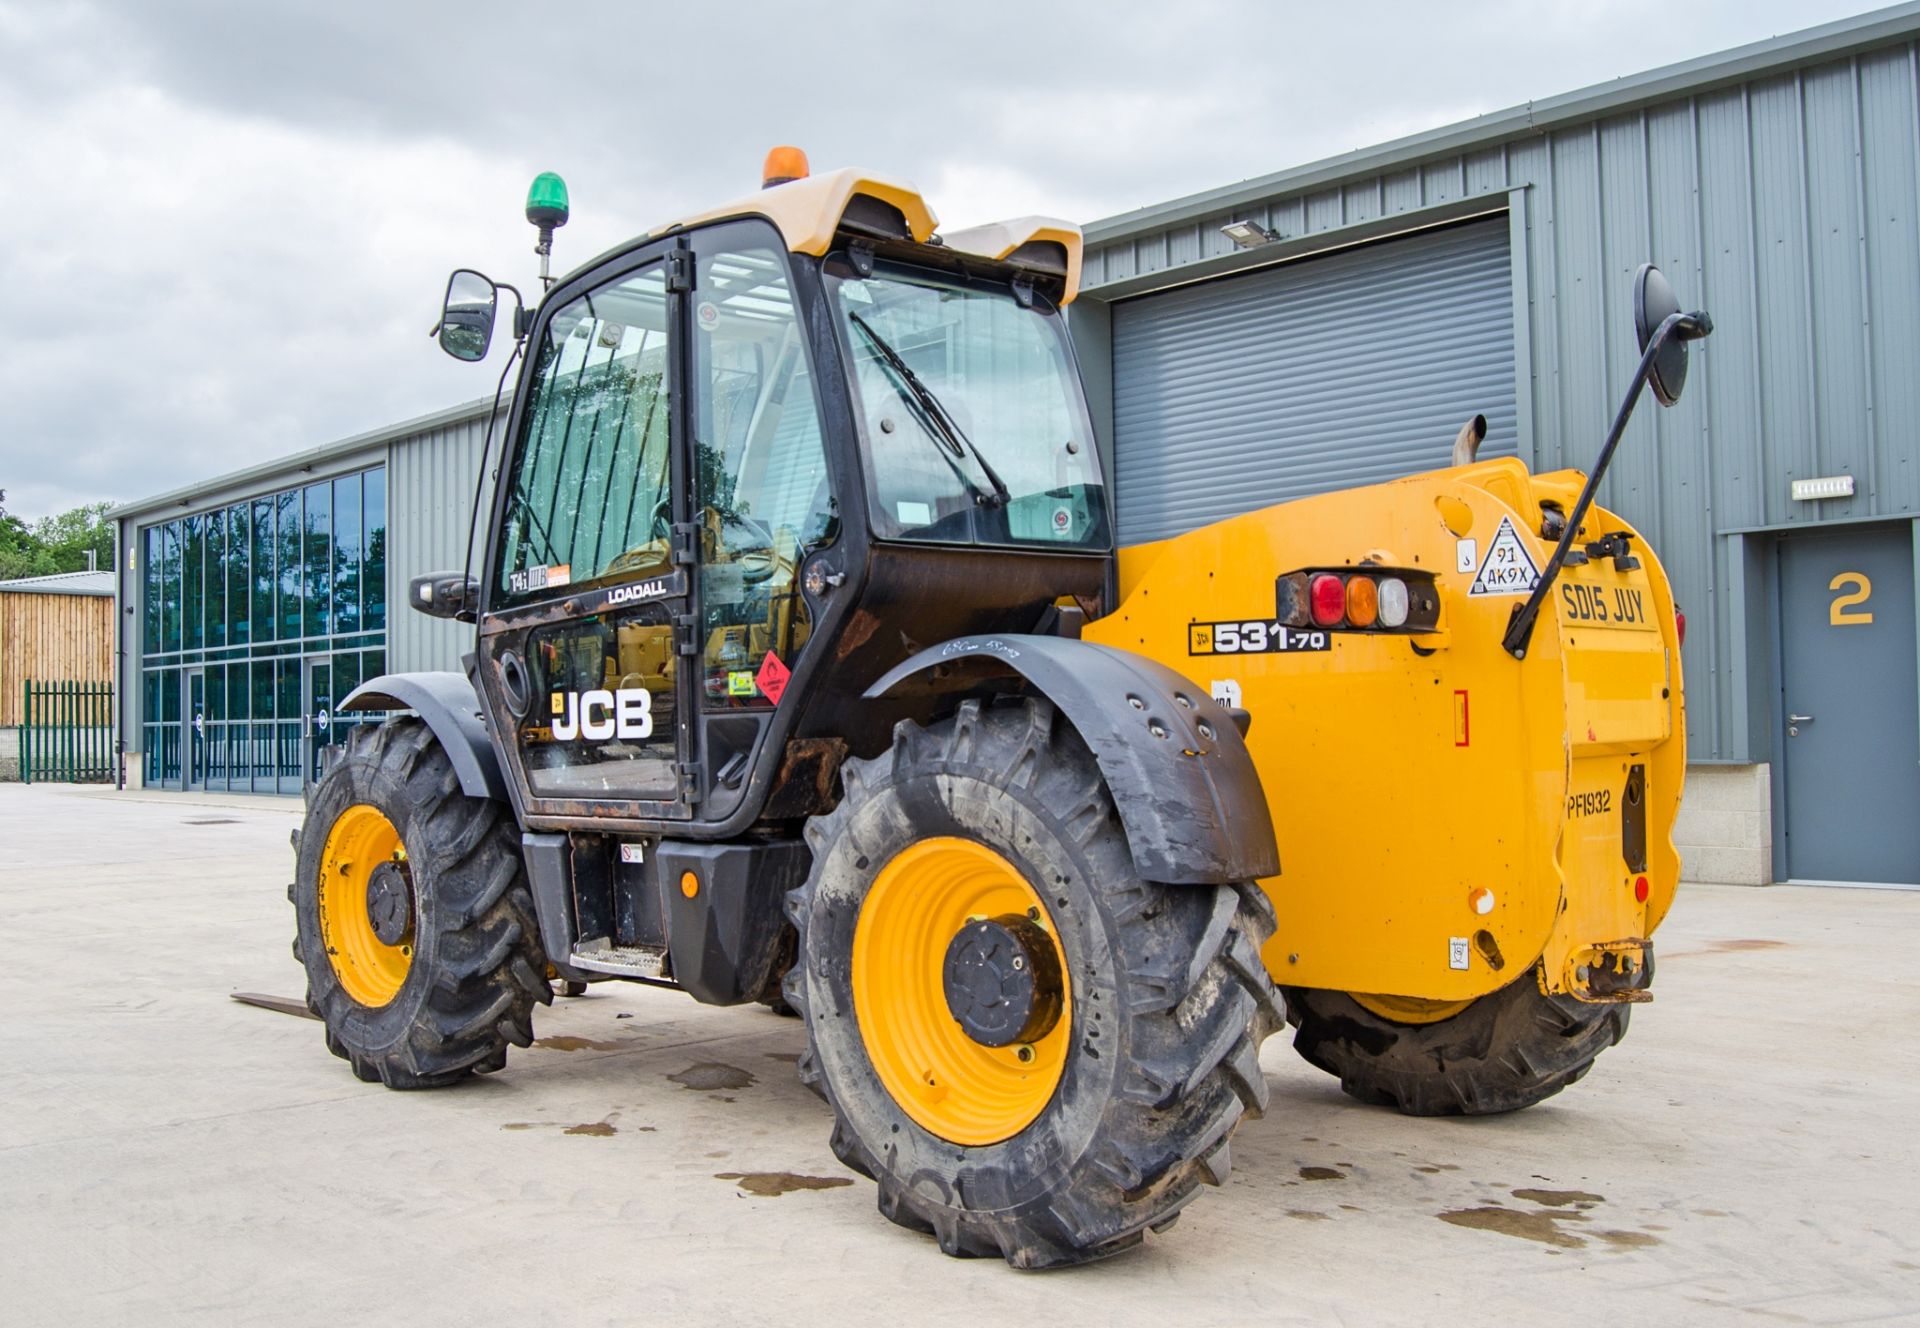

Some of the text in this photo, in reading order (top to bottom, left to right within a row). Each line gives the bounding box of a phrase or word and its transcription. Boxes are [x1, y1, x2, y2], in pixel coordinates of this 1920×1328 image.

[1497, 547, 1515, 563] 91
[1487, 566, 1528, 585] AK9X
[608, 580, 667, 605] LOADALL
[1562, 583, 1644, 624] SD15 JUY
[1829, 571, 1873, 626] 2
[551, 688, 654, 741] JCB
